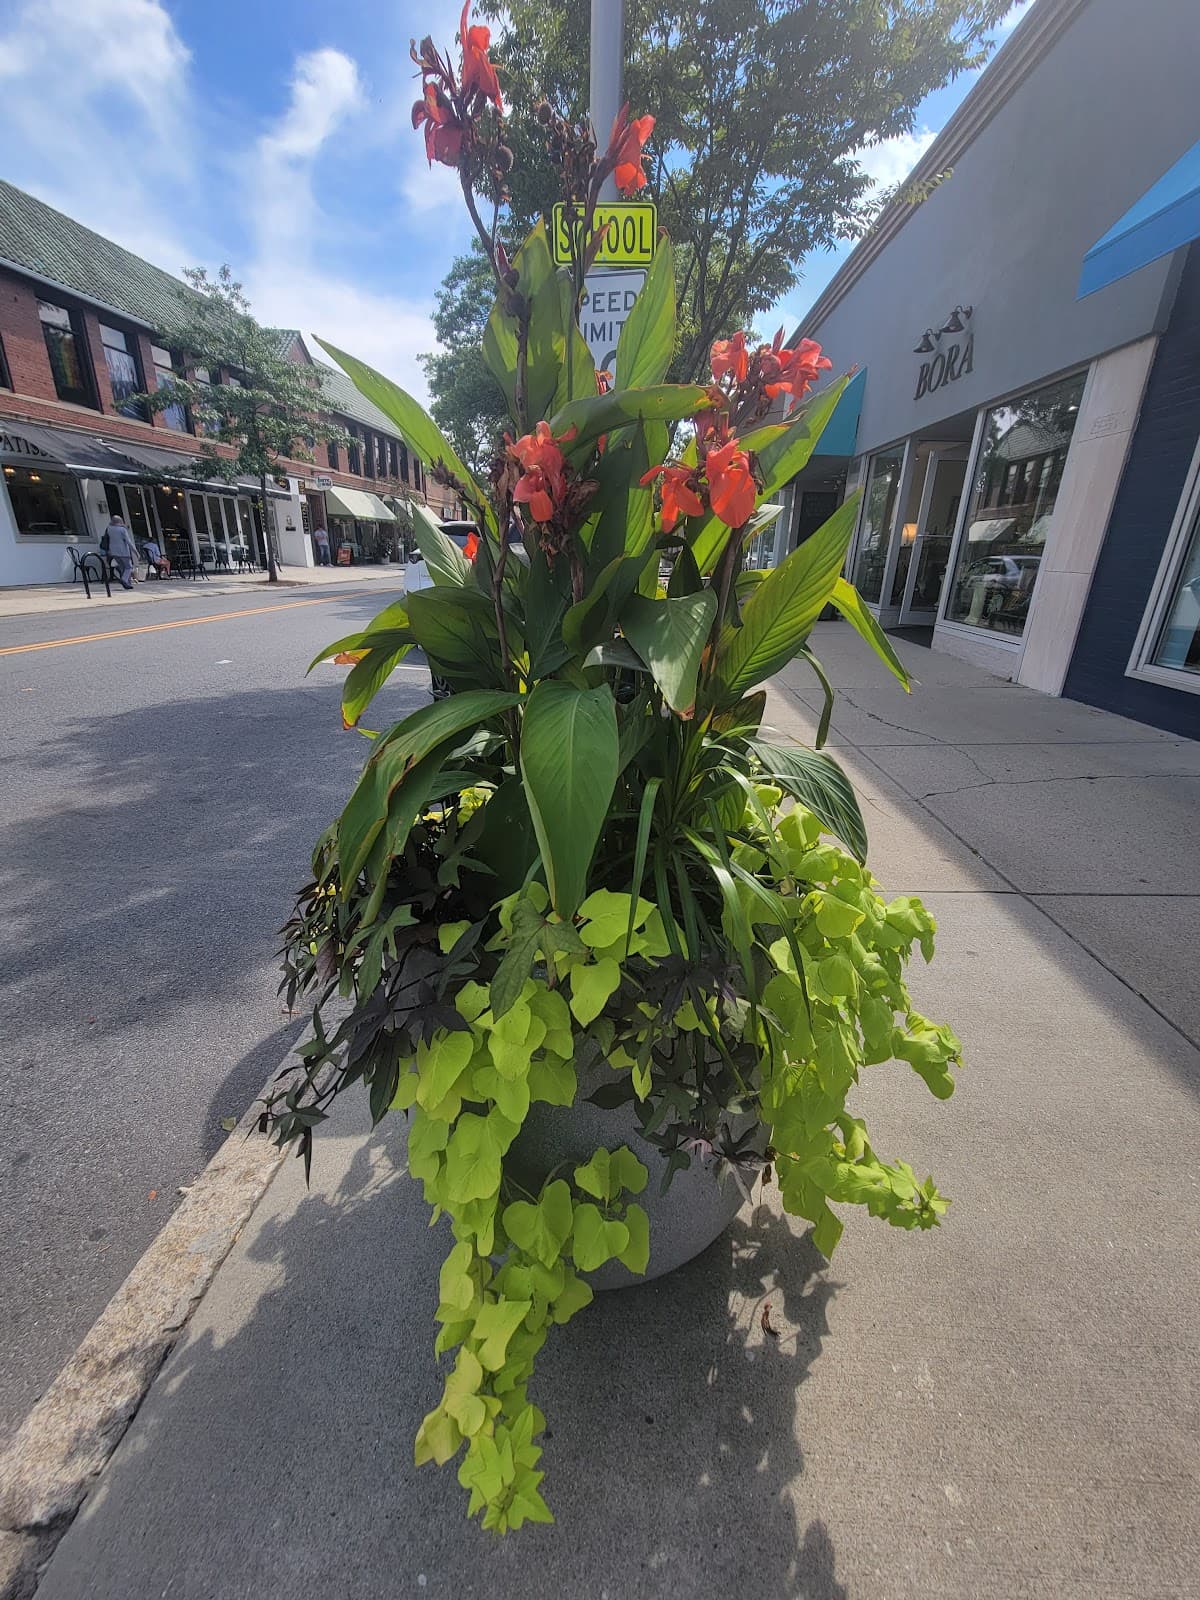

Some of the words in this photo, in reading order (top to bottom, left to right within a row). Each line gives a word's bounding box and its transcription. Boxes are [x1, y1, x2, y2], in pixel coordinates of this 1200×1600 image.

[580, 290, 638, 313] PEED
[583, 320, 627, 342] IMIT
[913, 333, 974, 401] BORA
